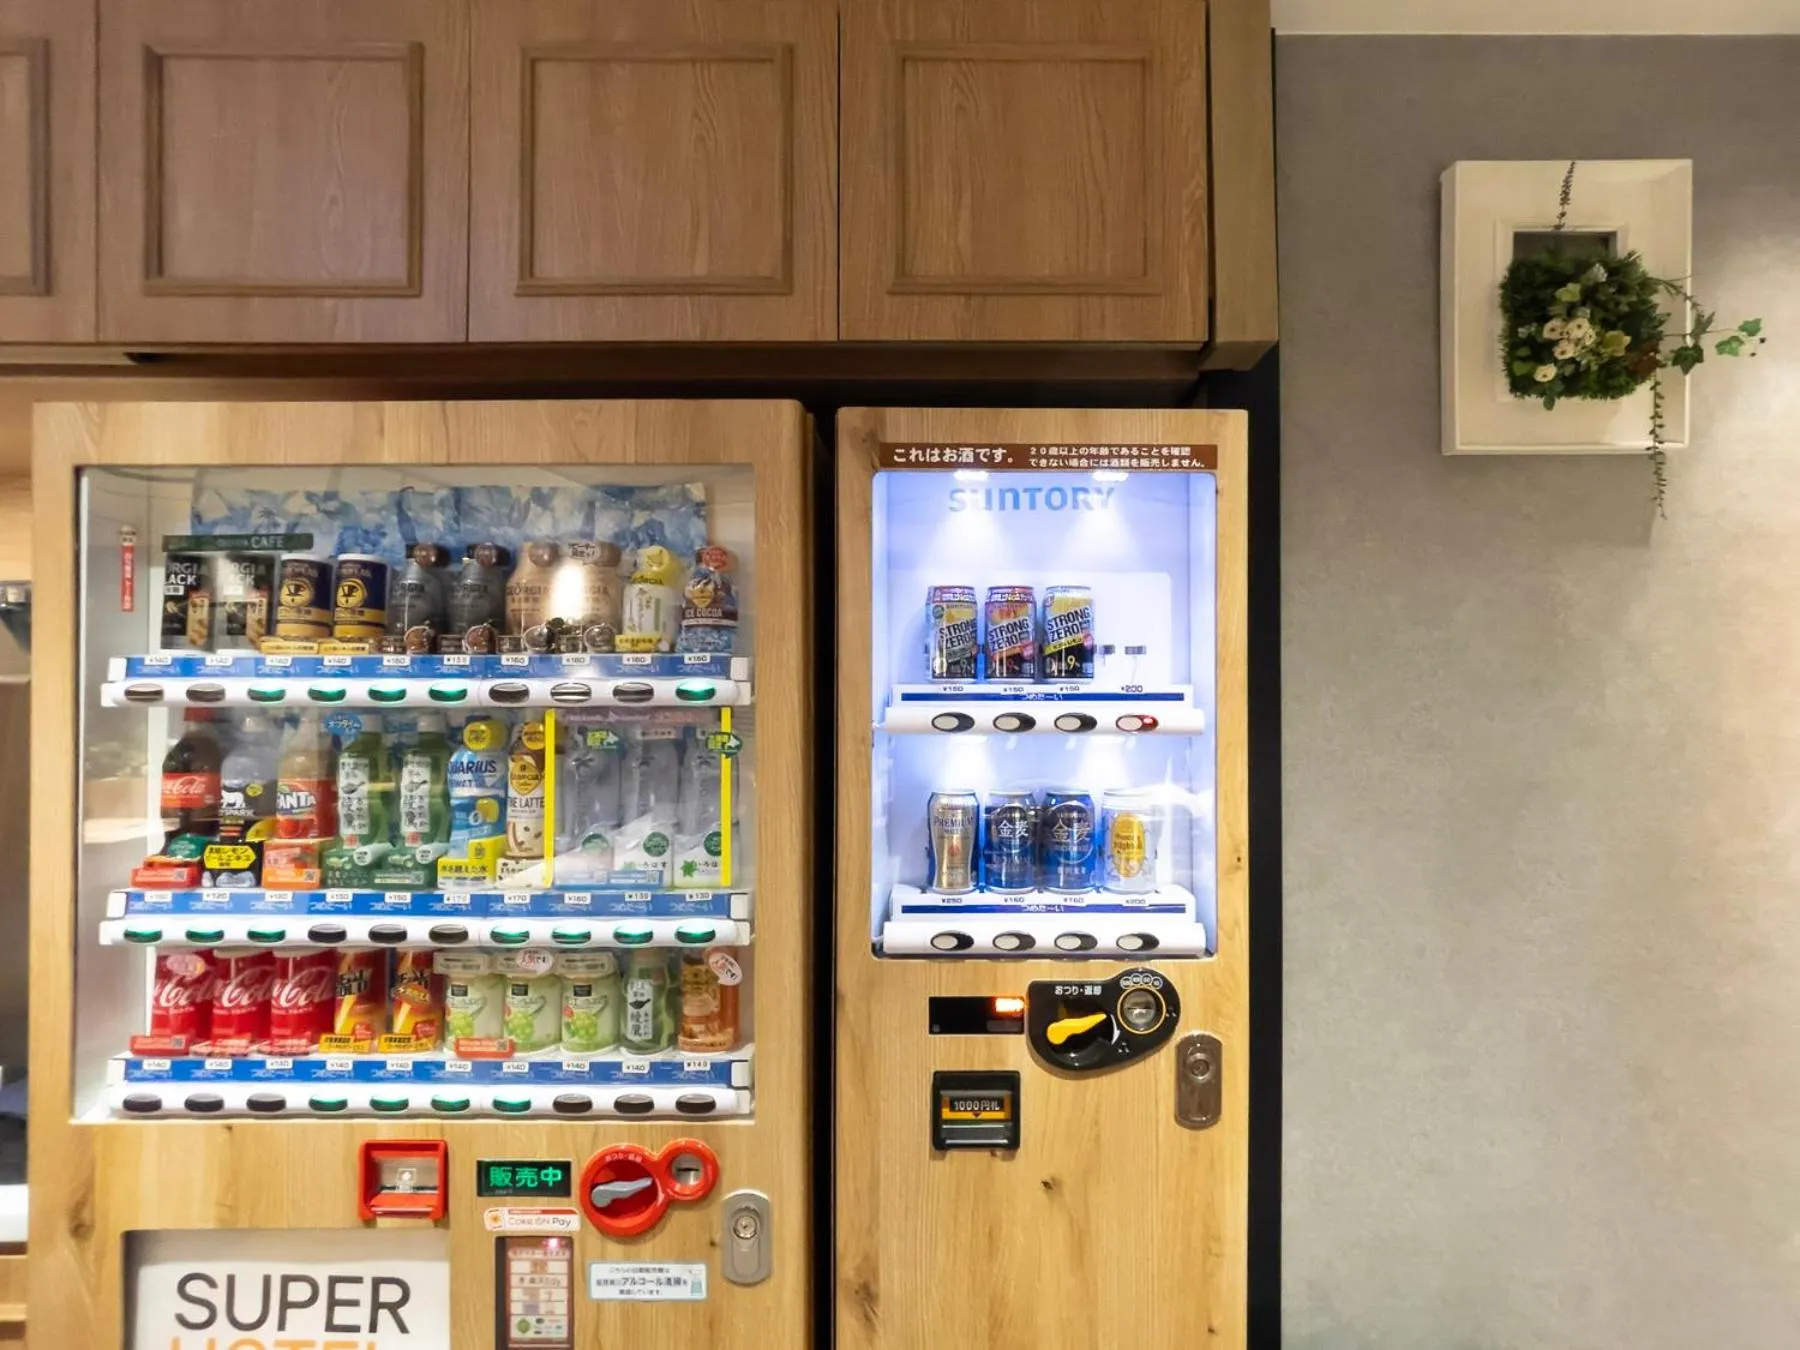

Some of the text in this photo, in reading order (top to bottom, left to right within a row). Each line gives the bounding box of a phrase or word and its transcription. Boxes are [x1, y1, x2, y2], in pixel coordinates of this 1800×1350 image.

[893, 447, 1013, 463] これはお酒です。
[988, 617, 1029, 639] STRONG
[1047, 606, 1090, 630] STRONG
[1049, 623, 1080, 643] ZERO
[998, 820, 1030, 838] 金麦
[1051, 819, 1092, 843] 金麦
[489, 1166, 563, 1188] 販売中
[551, 1217, 572, 1227] Pay
[174, 1272, 412, 1335] SUPER
